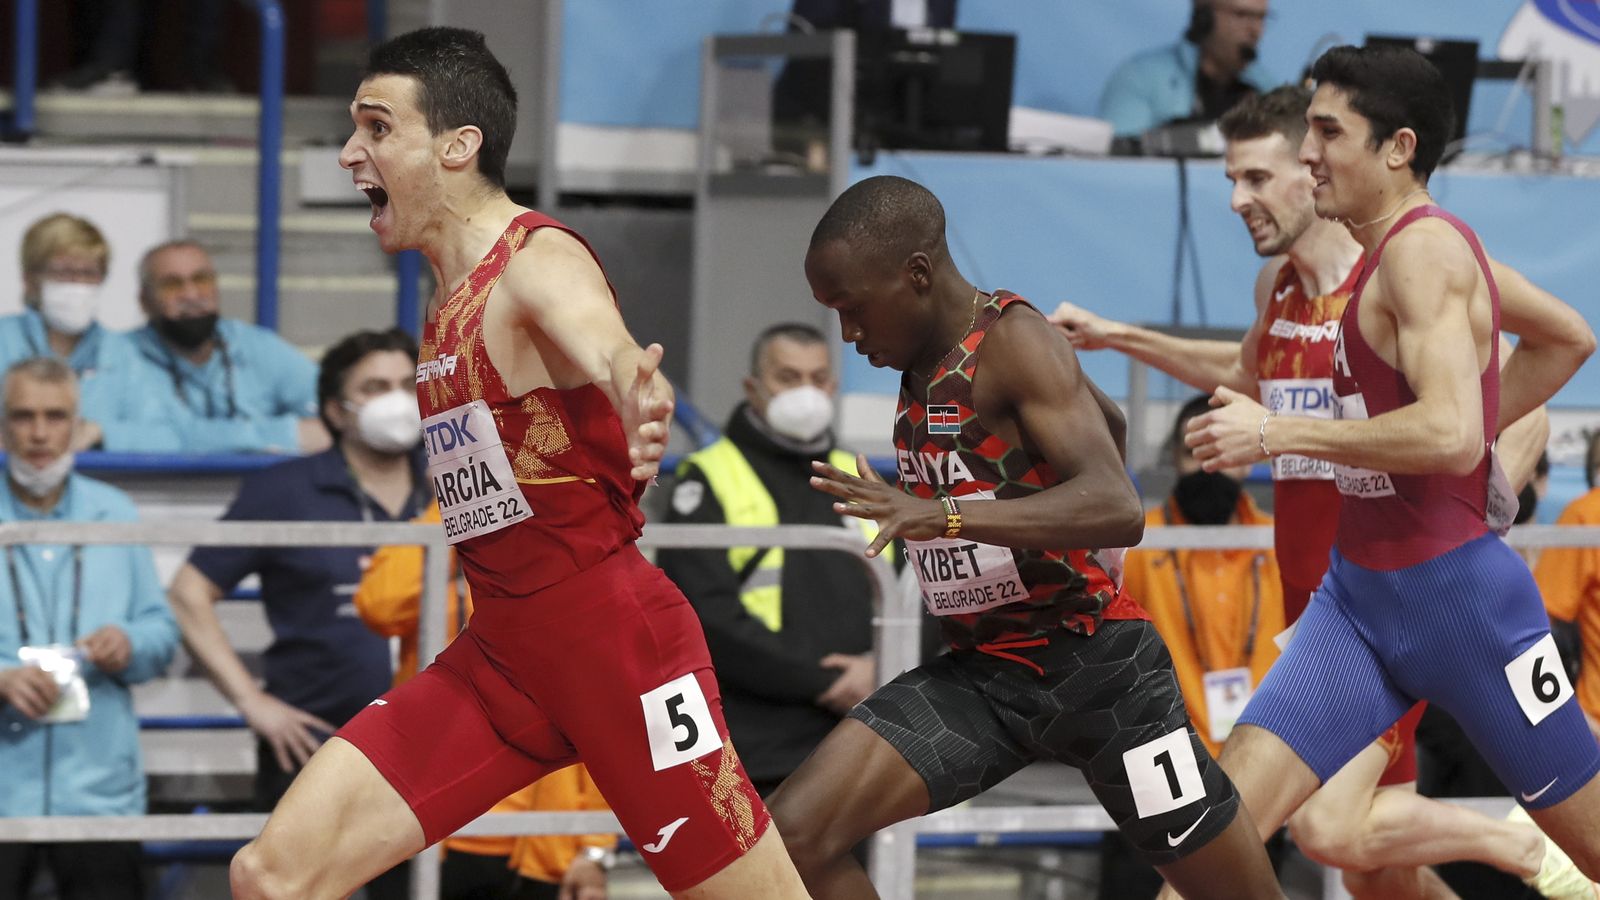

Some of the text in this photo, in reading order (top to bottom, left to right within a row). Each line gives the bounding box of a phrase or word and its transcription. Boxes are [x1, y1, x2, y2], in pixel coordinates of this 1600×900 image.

[416, 353, 458, 384] SPAÑA
[426, 413, 478, 455] TDK
[434, 456, 503, 509] ARCÍA
[897, 449, 976, 485] ENYA
[1281, 457, 1332, 475] BELGRAD
[1370, 475, 1390, 491] 22
[444, 497, 524, 538] BELGRADE 22
[916, 543, 982, 583] KIBET
[933, 580, 1021, 609] BELGRADE 22
[1531, 656, 1561, 703] 6
[665, 692, 699, 752] 5
[1153, 749, 1184, 801] 1
